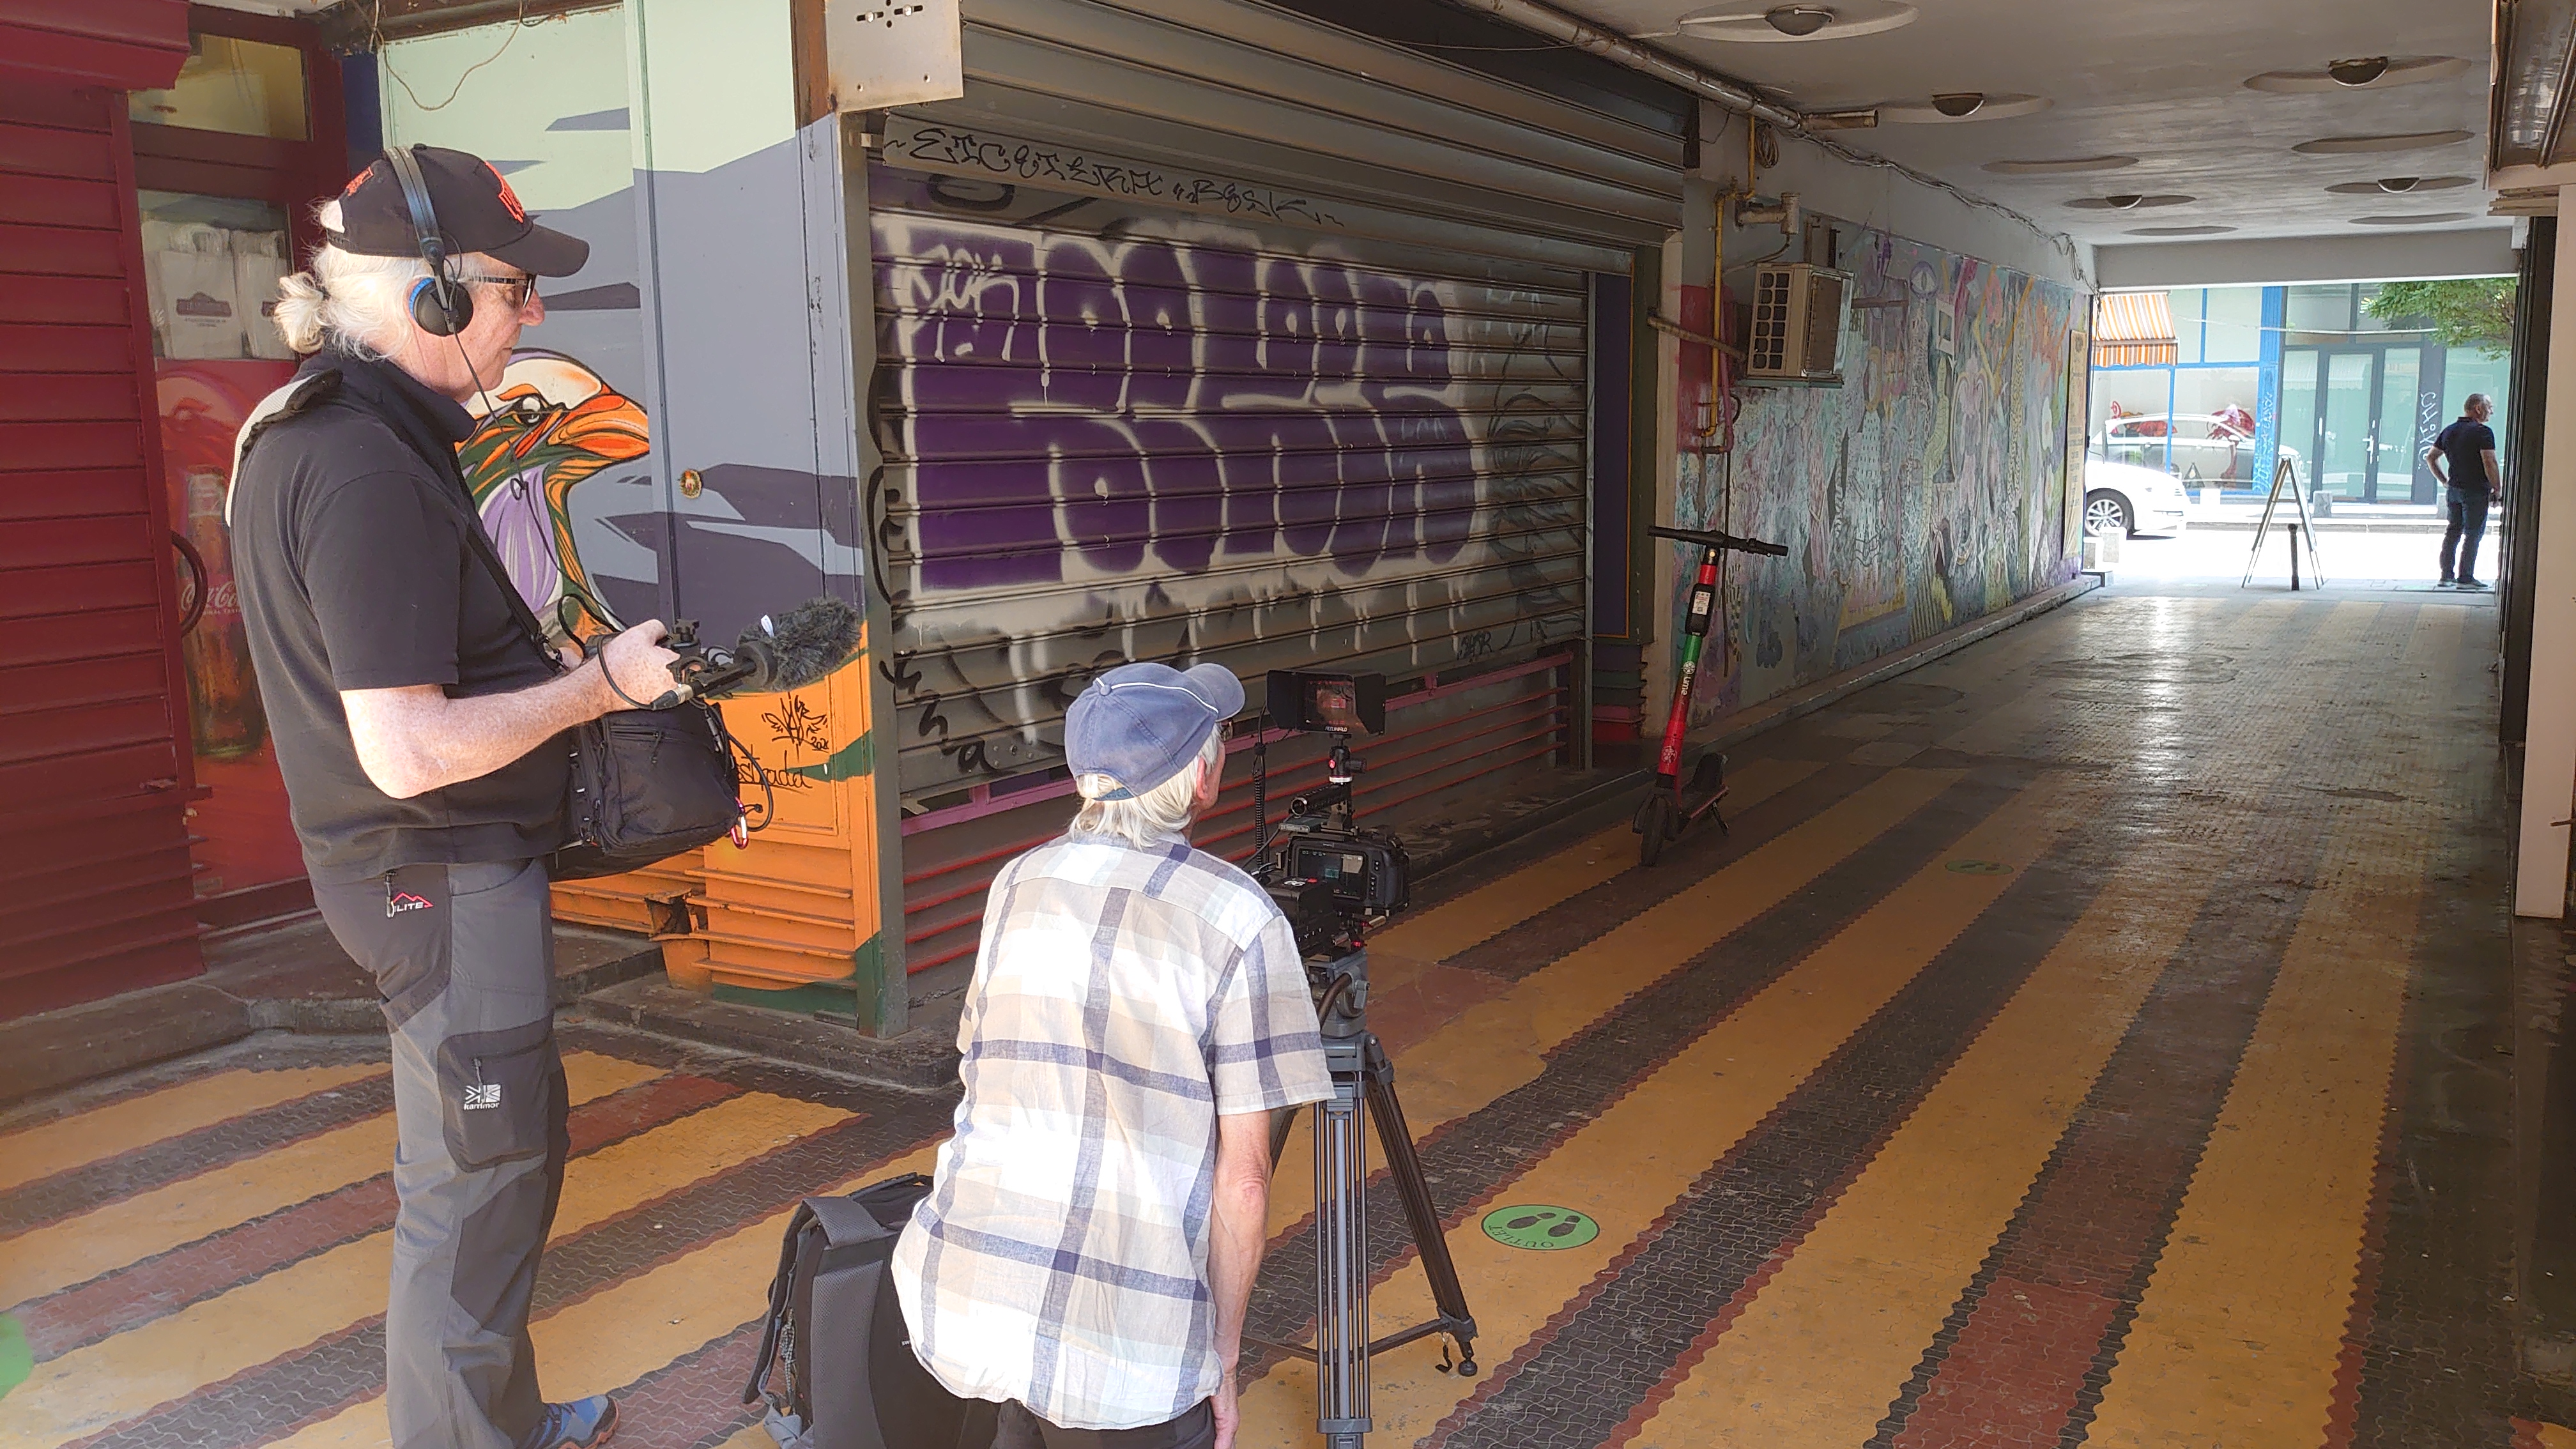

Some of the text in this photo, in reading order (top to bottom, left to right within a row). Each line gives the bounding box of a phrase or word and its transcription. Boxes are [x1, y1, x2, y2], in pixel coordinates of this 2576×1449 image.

[1681, 676, 1691, 696] Lime
[463, 1102, 500, 1110] karrimor
[1488, 1225, 1554, 1248] OUTLET
